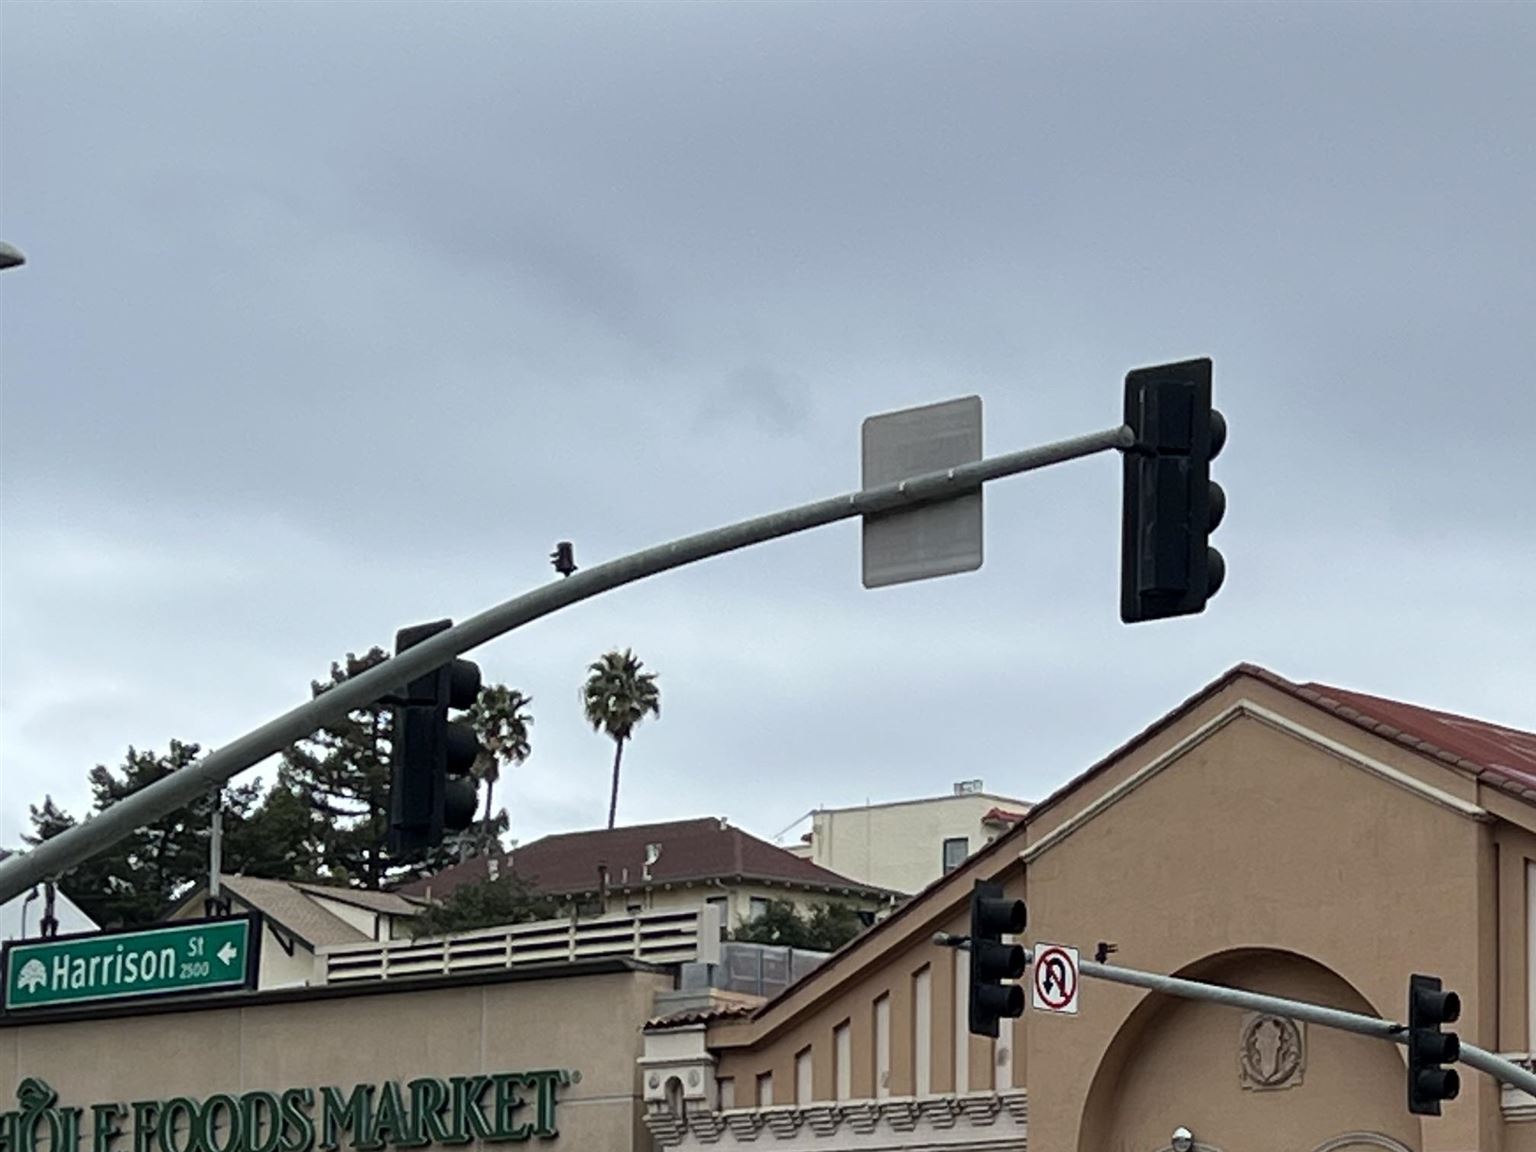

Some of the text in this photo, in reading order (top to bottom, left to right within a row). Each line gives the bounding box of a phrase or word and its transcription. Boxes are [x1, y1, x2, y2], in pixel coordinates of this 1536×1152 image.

[51, 936, 204, 991] Harrison St
[179, 961, 210, 979] 2500
[319, 1069, 571, 1152] MARKET
